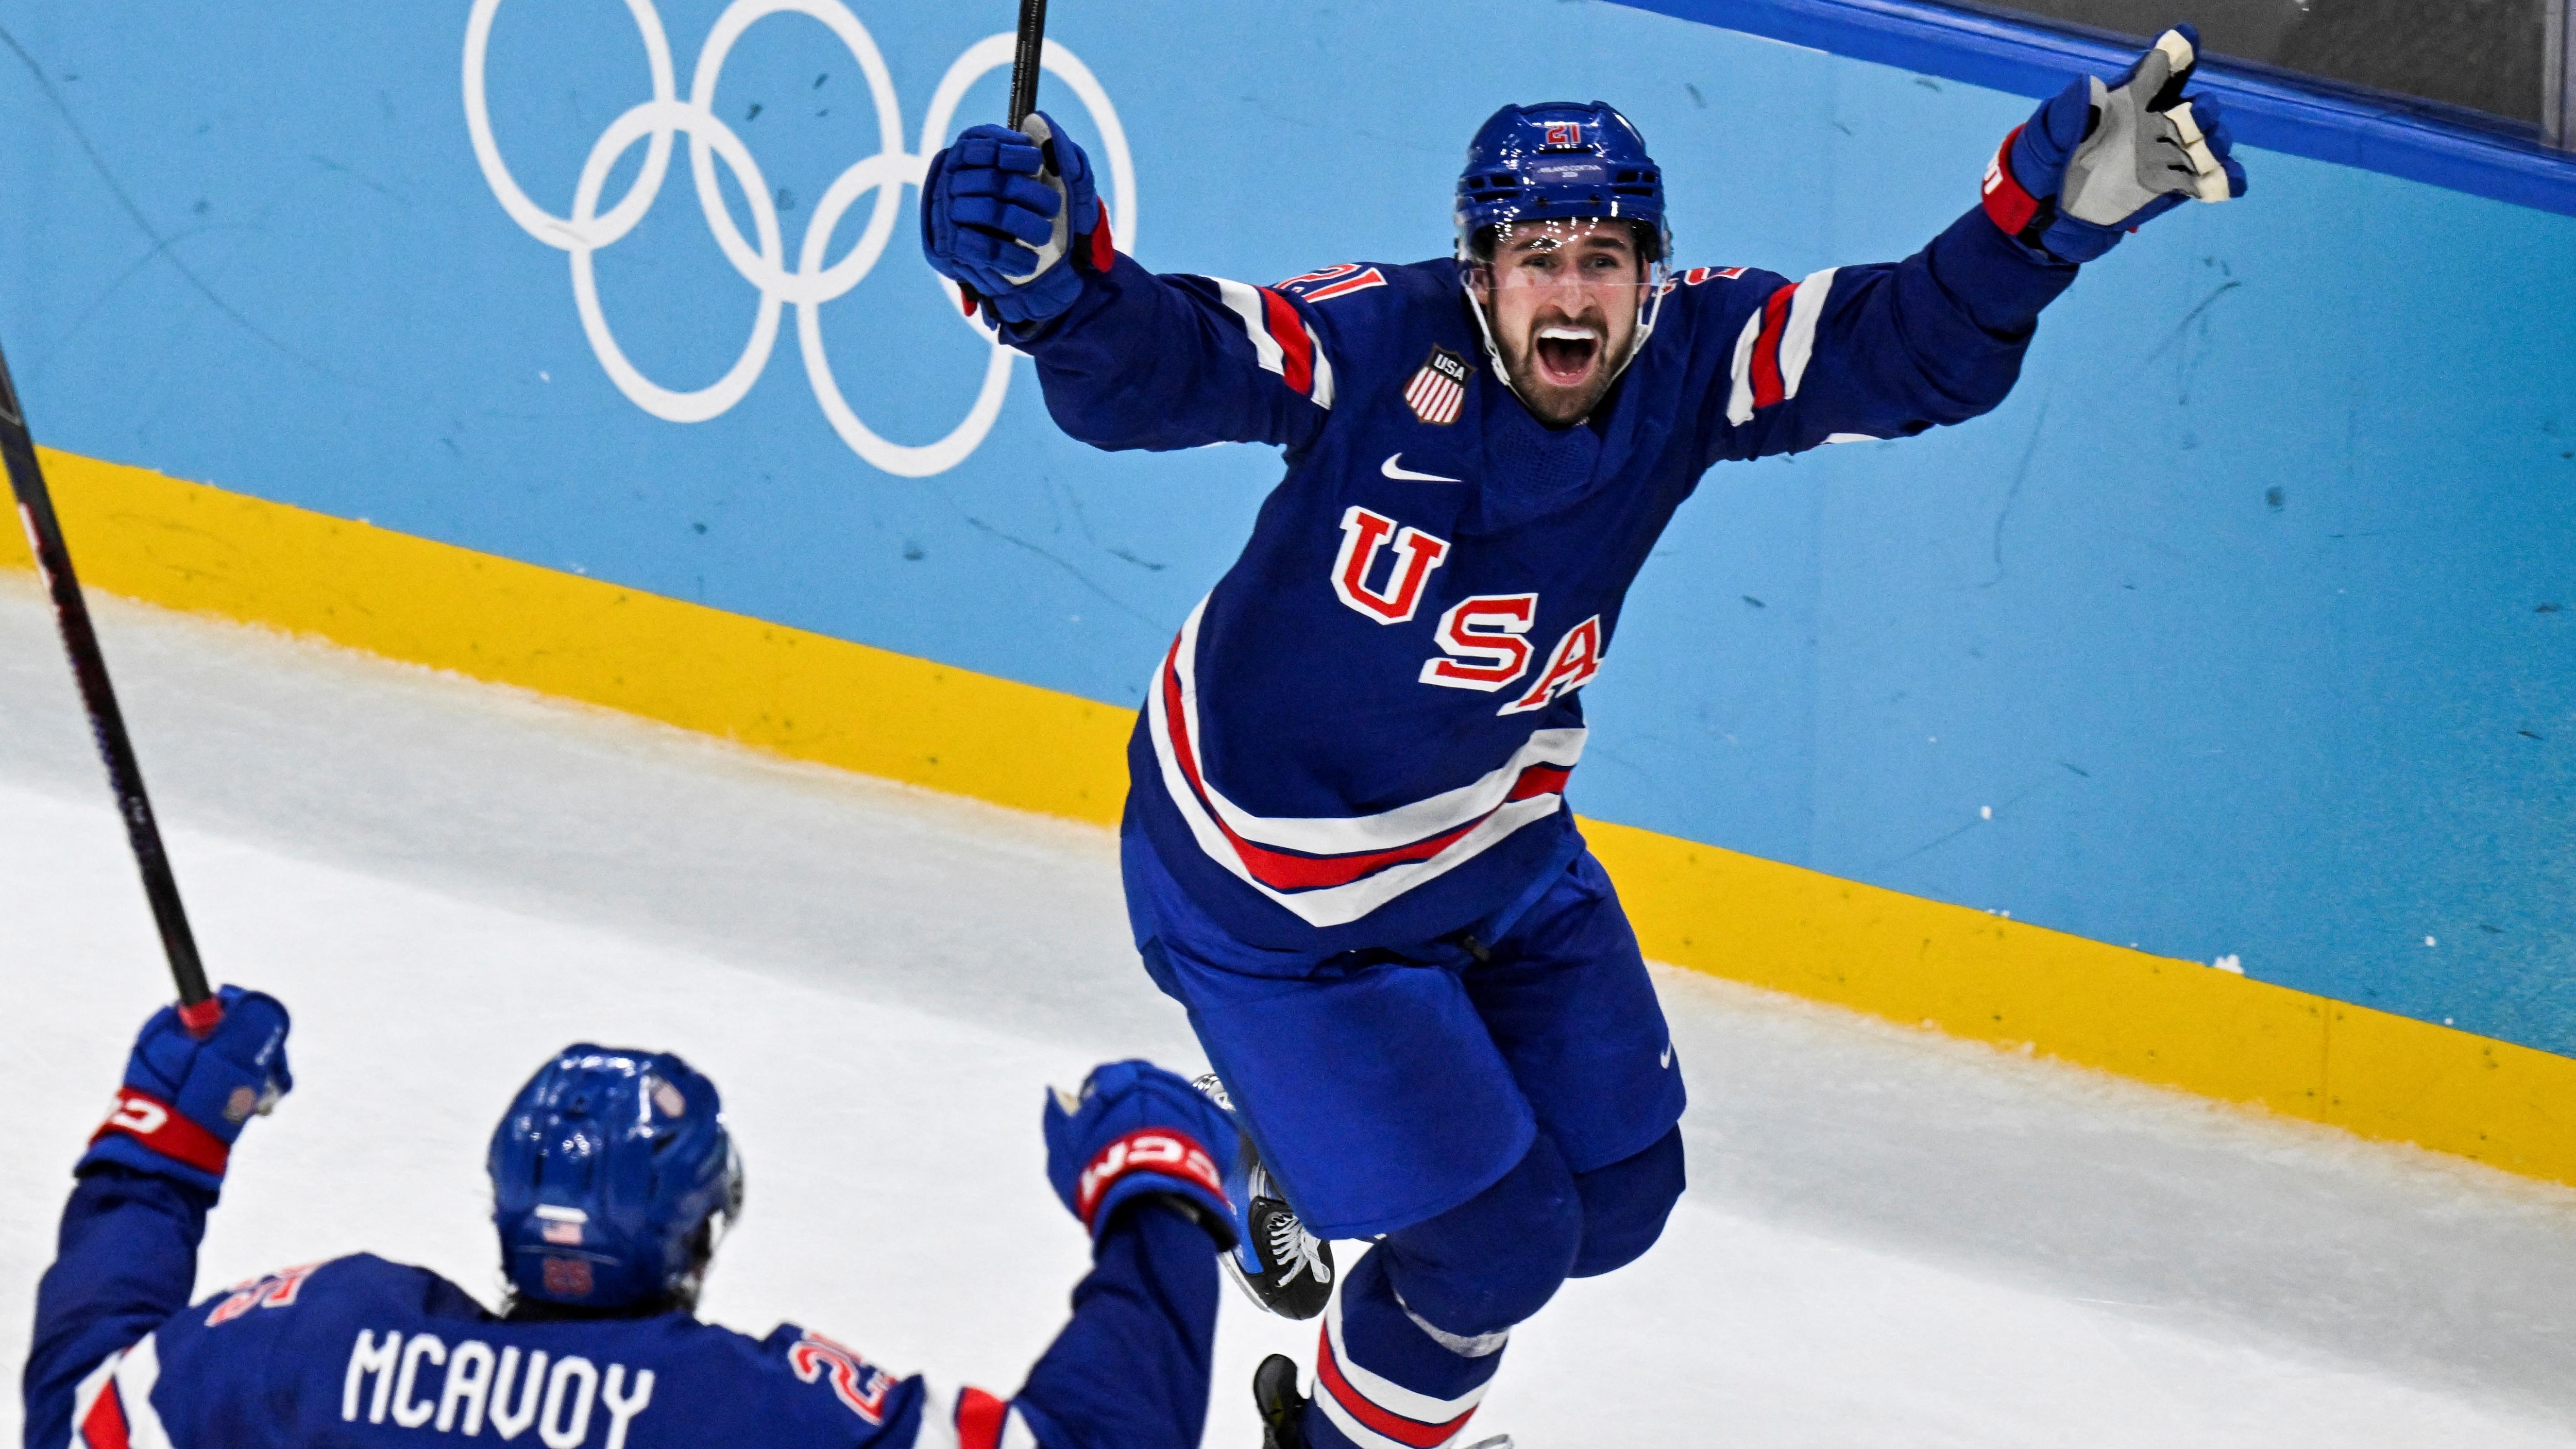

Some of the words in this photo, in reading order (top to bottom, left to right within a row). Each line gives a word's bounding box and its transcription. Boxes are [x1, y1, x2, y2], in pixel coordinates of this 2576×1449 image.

[1545, 124, 1581, 145] 21
[1434, 354, 1466, 382] USA
[1330, 505, 1605, 717] USA
[341, 1328, 655, 1449] MCAVOY
